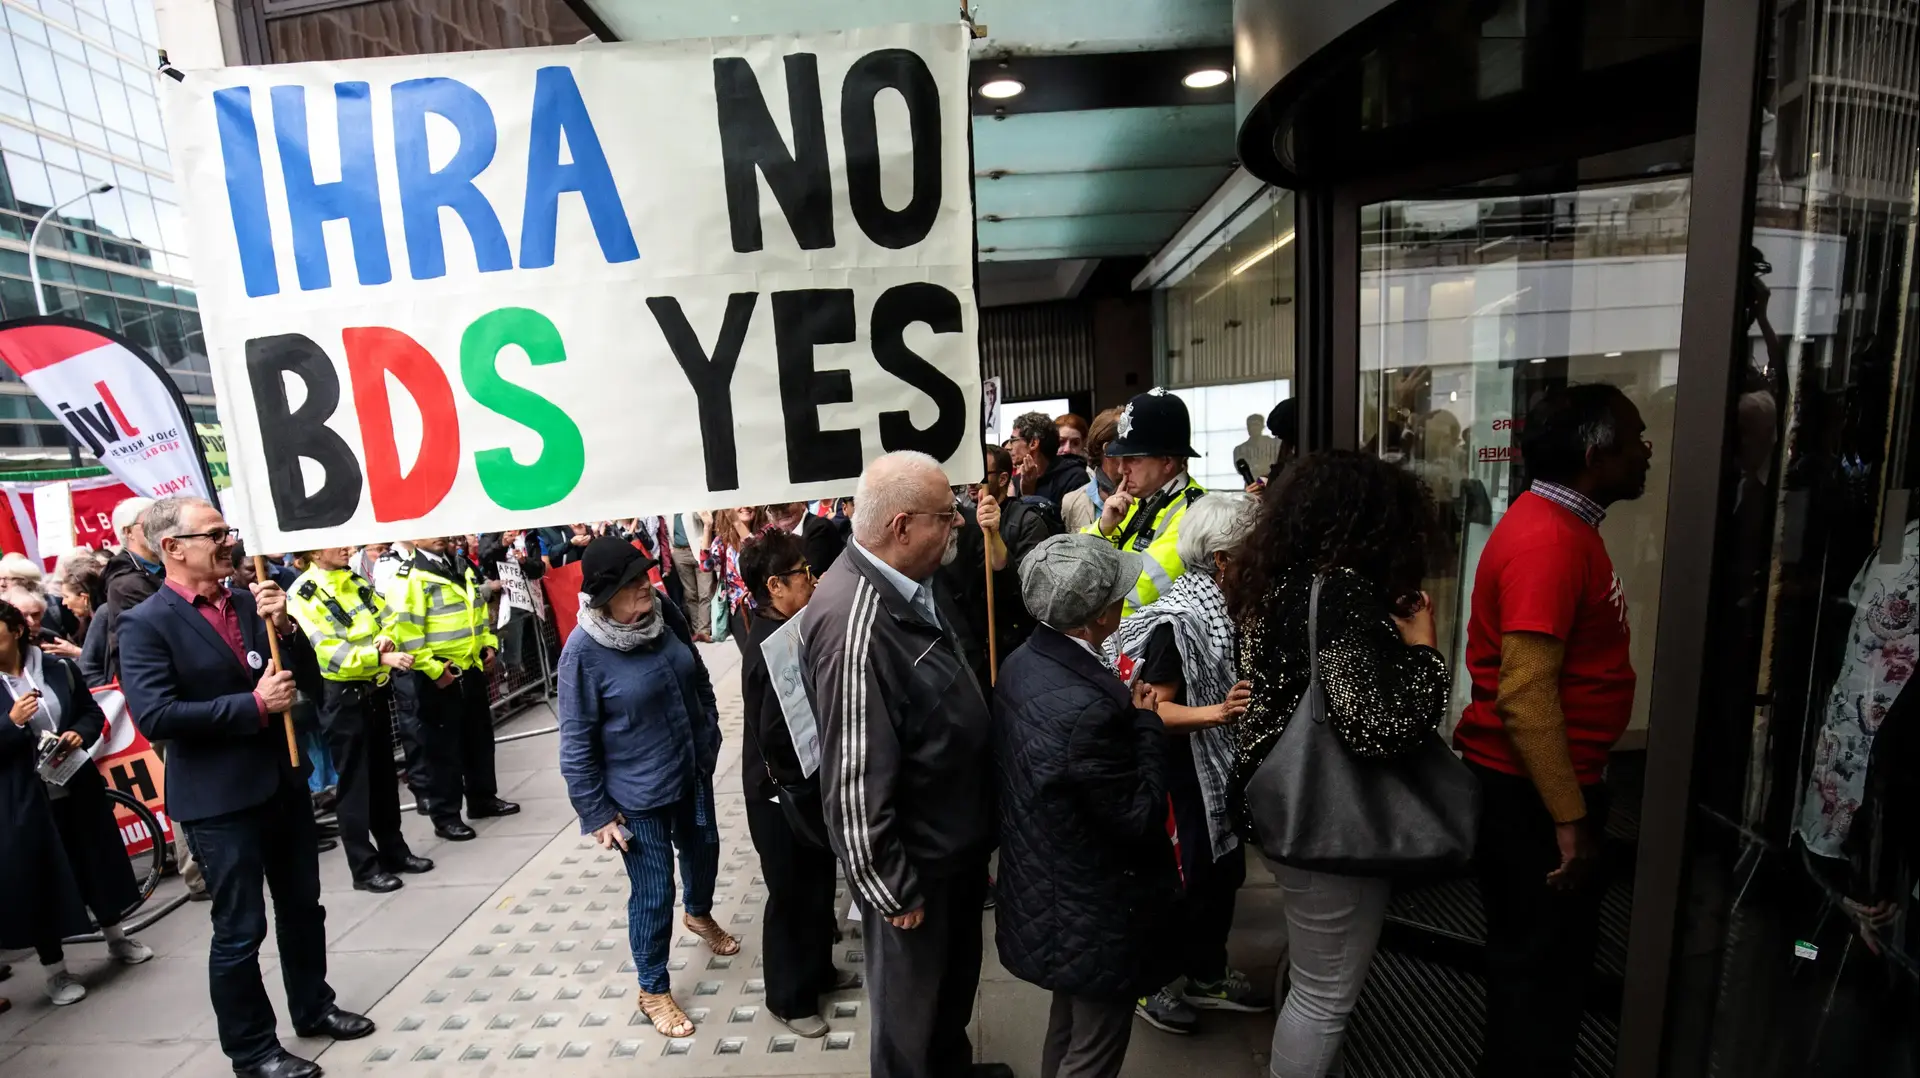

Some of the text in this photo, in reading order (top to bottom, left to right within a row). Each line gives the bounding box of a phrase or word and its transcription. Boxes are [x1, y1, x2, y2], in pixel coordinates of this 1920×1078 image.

[213, 48, 941, 297] IHRA NO
[140, 441, 180, 461] LABOUR
[147, 428, 178, 443] VOICE
[245, 281, 966, 532] BDS YES
